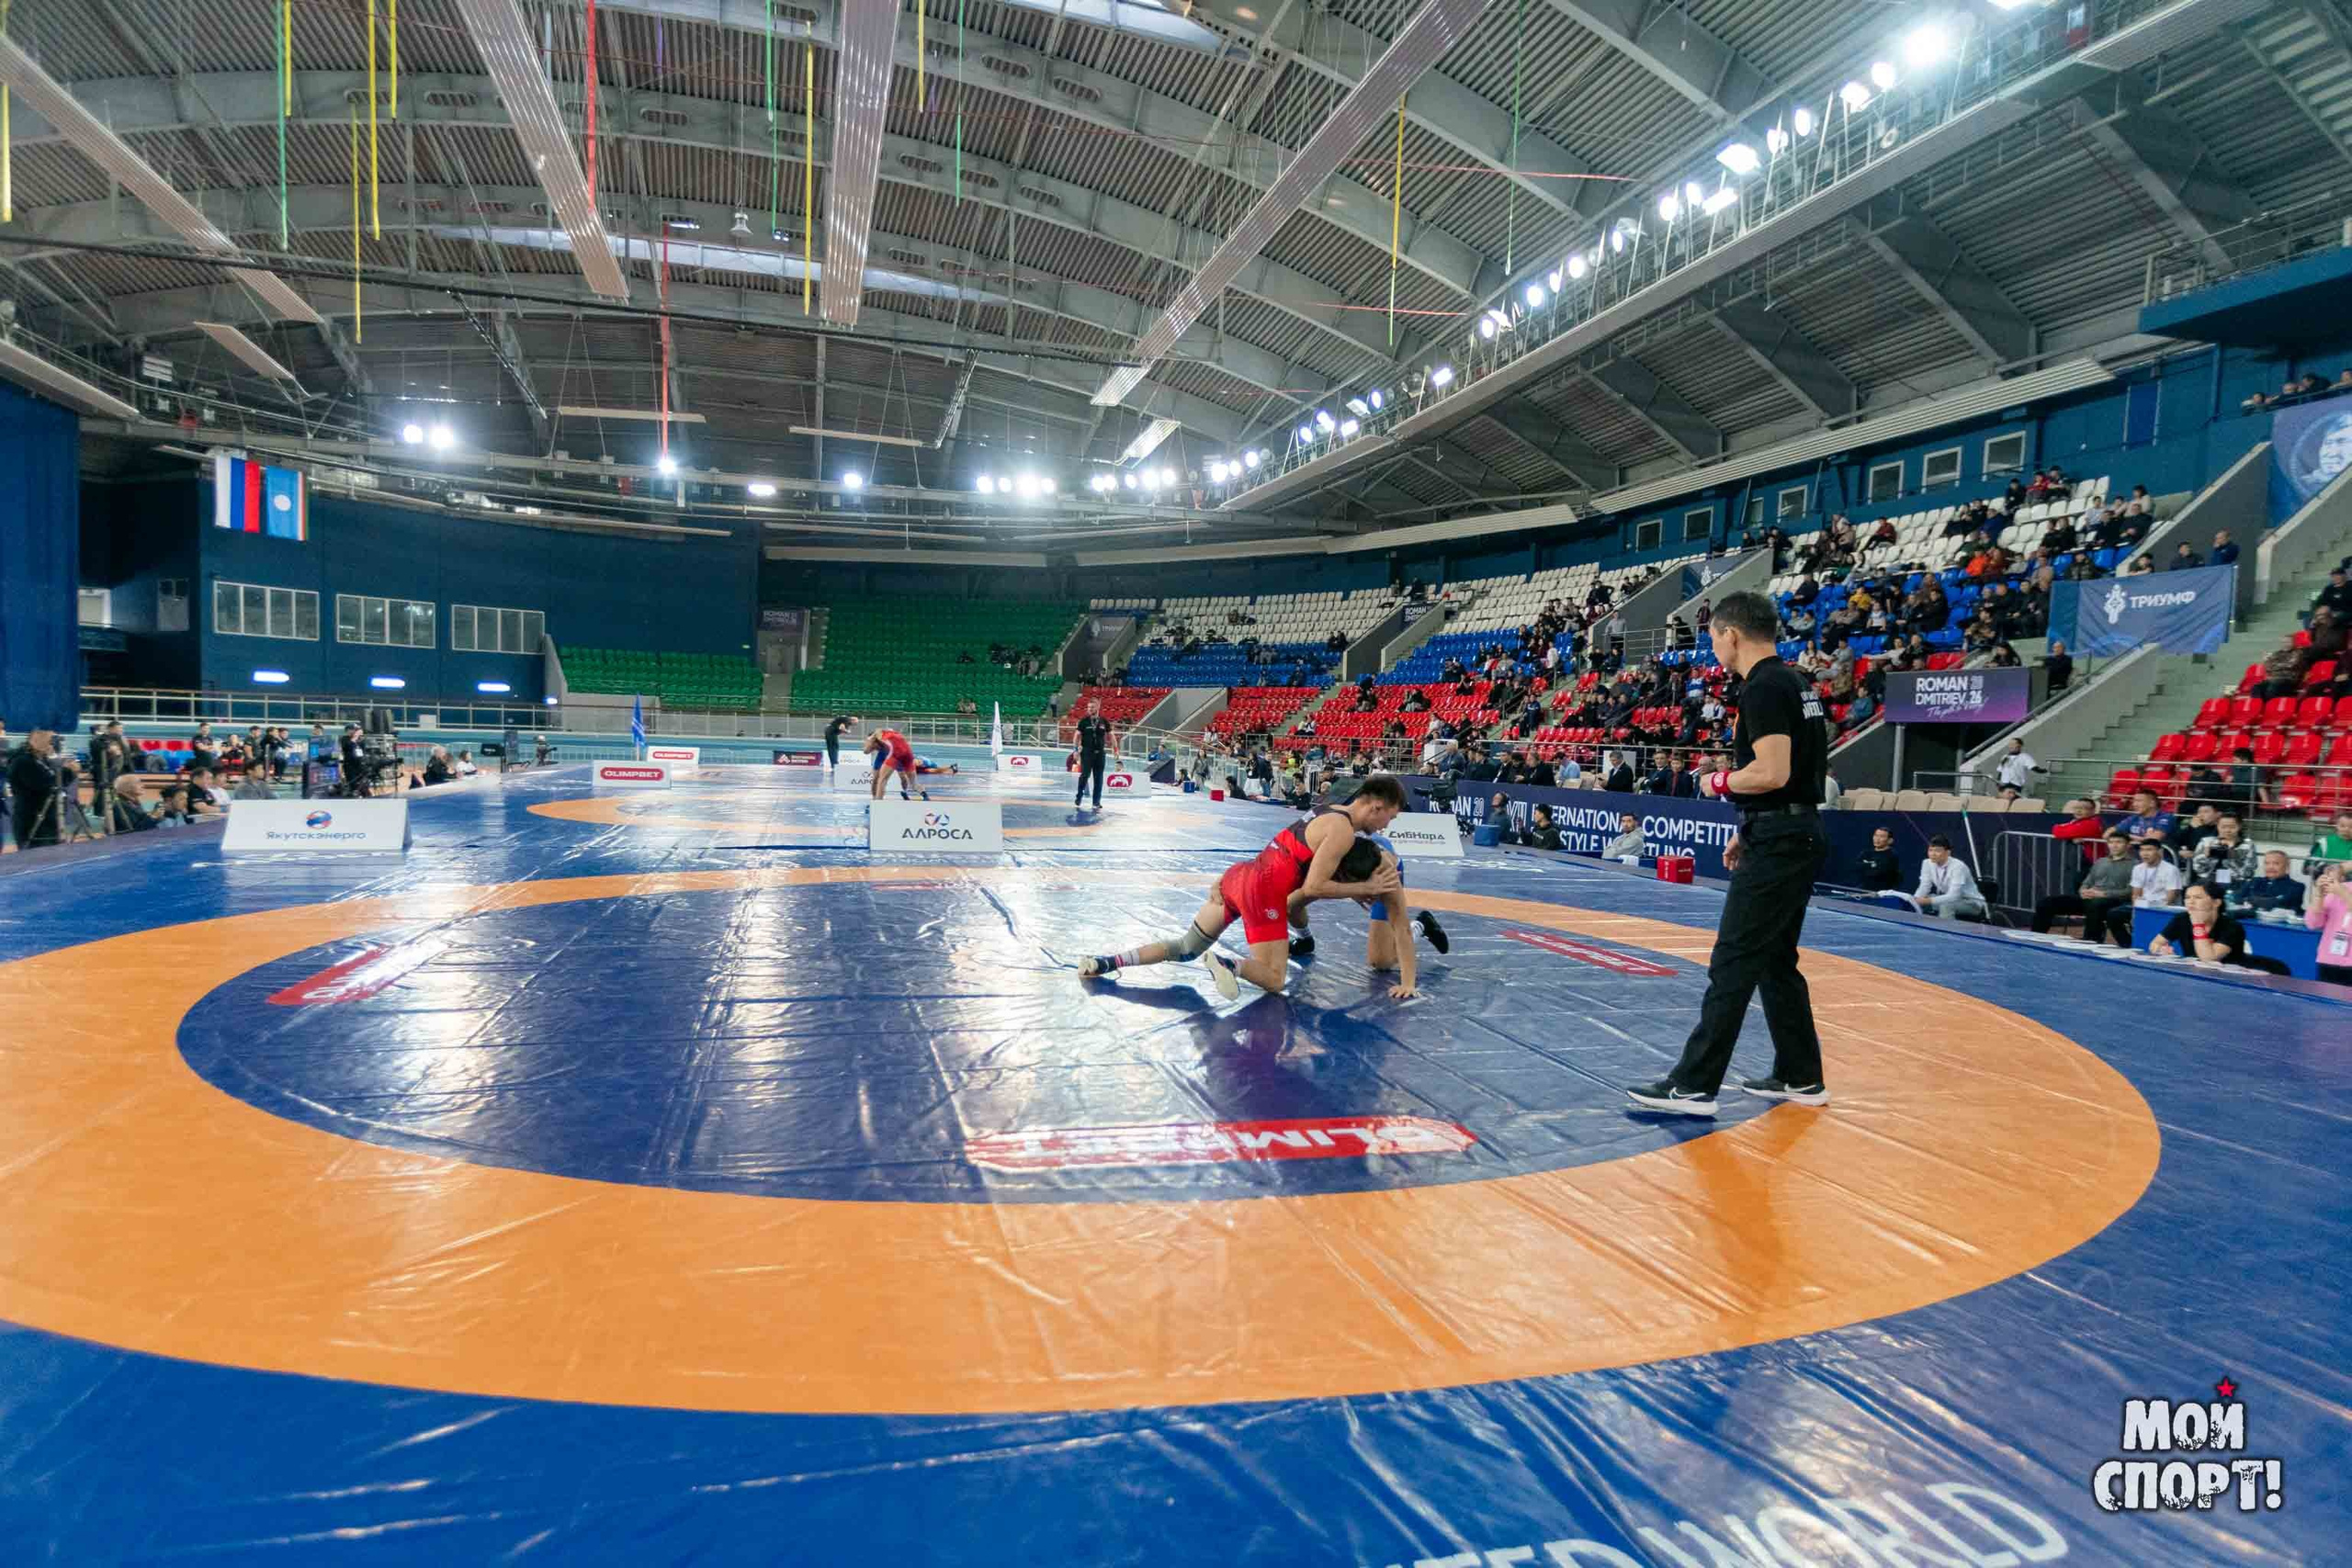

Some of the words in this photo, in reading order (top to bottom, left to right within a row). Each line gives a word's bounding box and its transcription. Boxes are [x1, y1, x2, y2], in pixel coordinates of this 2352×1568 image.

[2129, 591, 2197, 608] ТРИУМФ
[1916, 676, 1968, 692] ROMAN
[1915, 692, 1967, 705] DMITRIEV
[605, 770, 661, 779] OLIMPBET
[266, 831, 367, 840] Якутскэнерго
